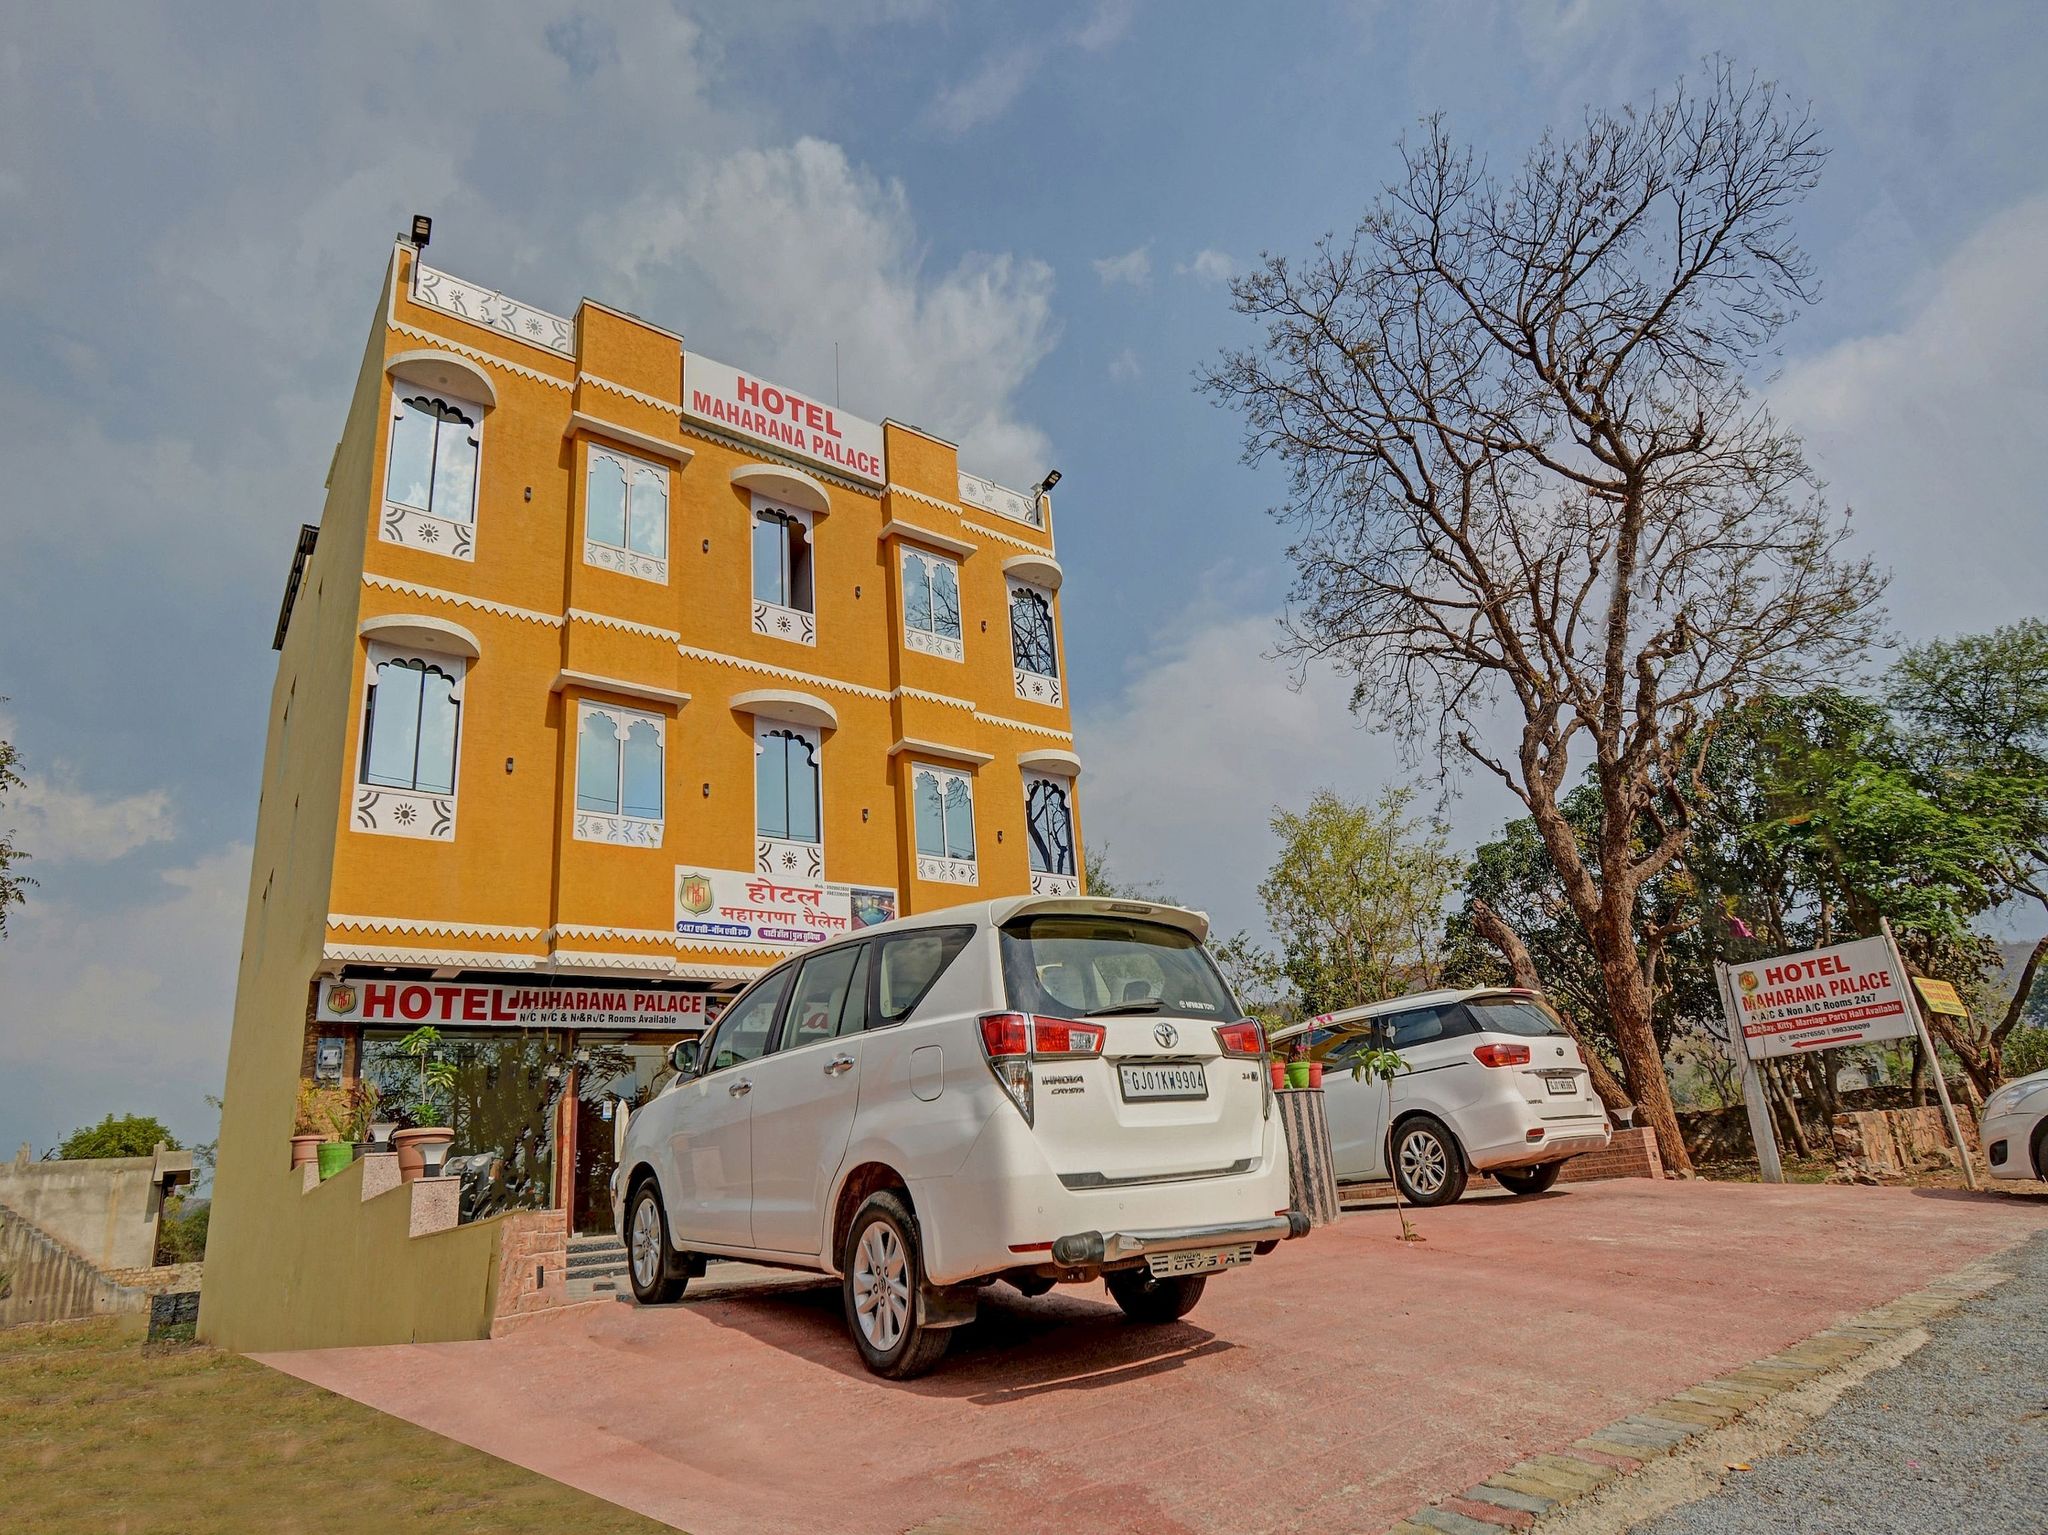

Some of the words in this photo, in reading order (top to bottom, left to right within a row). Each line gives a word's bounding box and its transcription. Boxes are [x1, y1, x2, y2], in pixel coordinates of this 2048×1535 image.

[737, 376, 842, 438] HOTEL
[693, 390, 806, 449] MAHARANA
[812, 434, 880, 477] PALACE
[745, 878, 823, 907] होटल
[719, 906, 797, 926] महाराणा
[803, 907, 847, 930] पैलेस
[1765, 955, 1850, 985] HOTEL
[362, 984, 517, 1022] HOTEL
[633, 993, 702, 1013] PALACE
[1741, 982, 1826, 1012] MAHARANA
[1829, 971, 1891, 997] PALACE
[1777, 1008, 1785, 1018] &
[1787, 1006, 1803, 1016] Non
[1806, 1002, 1821, 1013] A/C
[1824, 999, 1853, 1010] Rooms
[1855, 993, 1877, 1005] 24x7
[608, 1013, 636, 1024] Rooms
[638, 1013, 677, 1024] Available
[1796, 1016, 1827, 1028] Marriage
[1829, 1012, 1848, 1023] Party
[1850, 1008, 1864, 1018] Hall
[1866, 1004, 1900, 1015] Available
